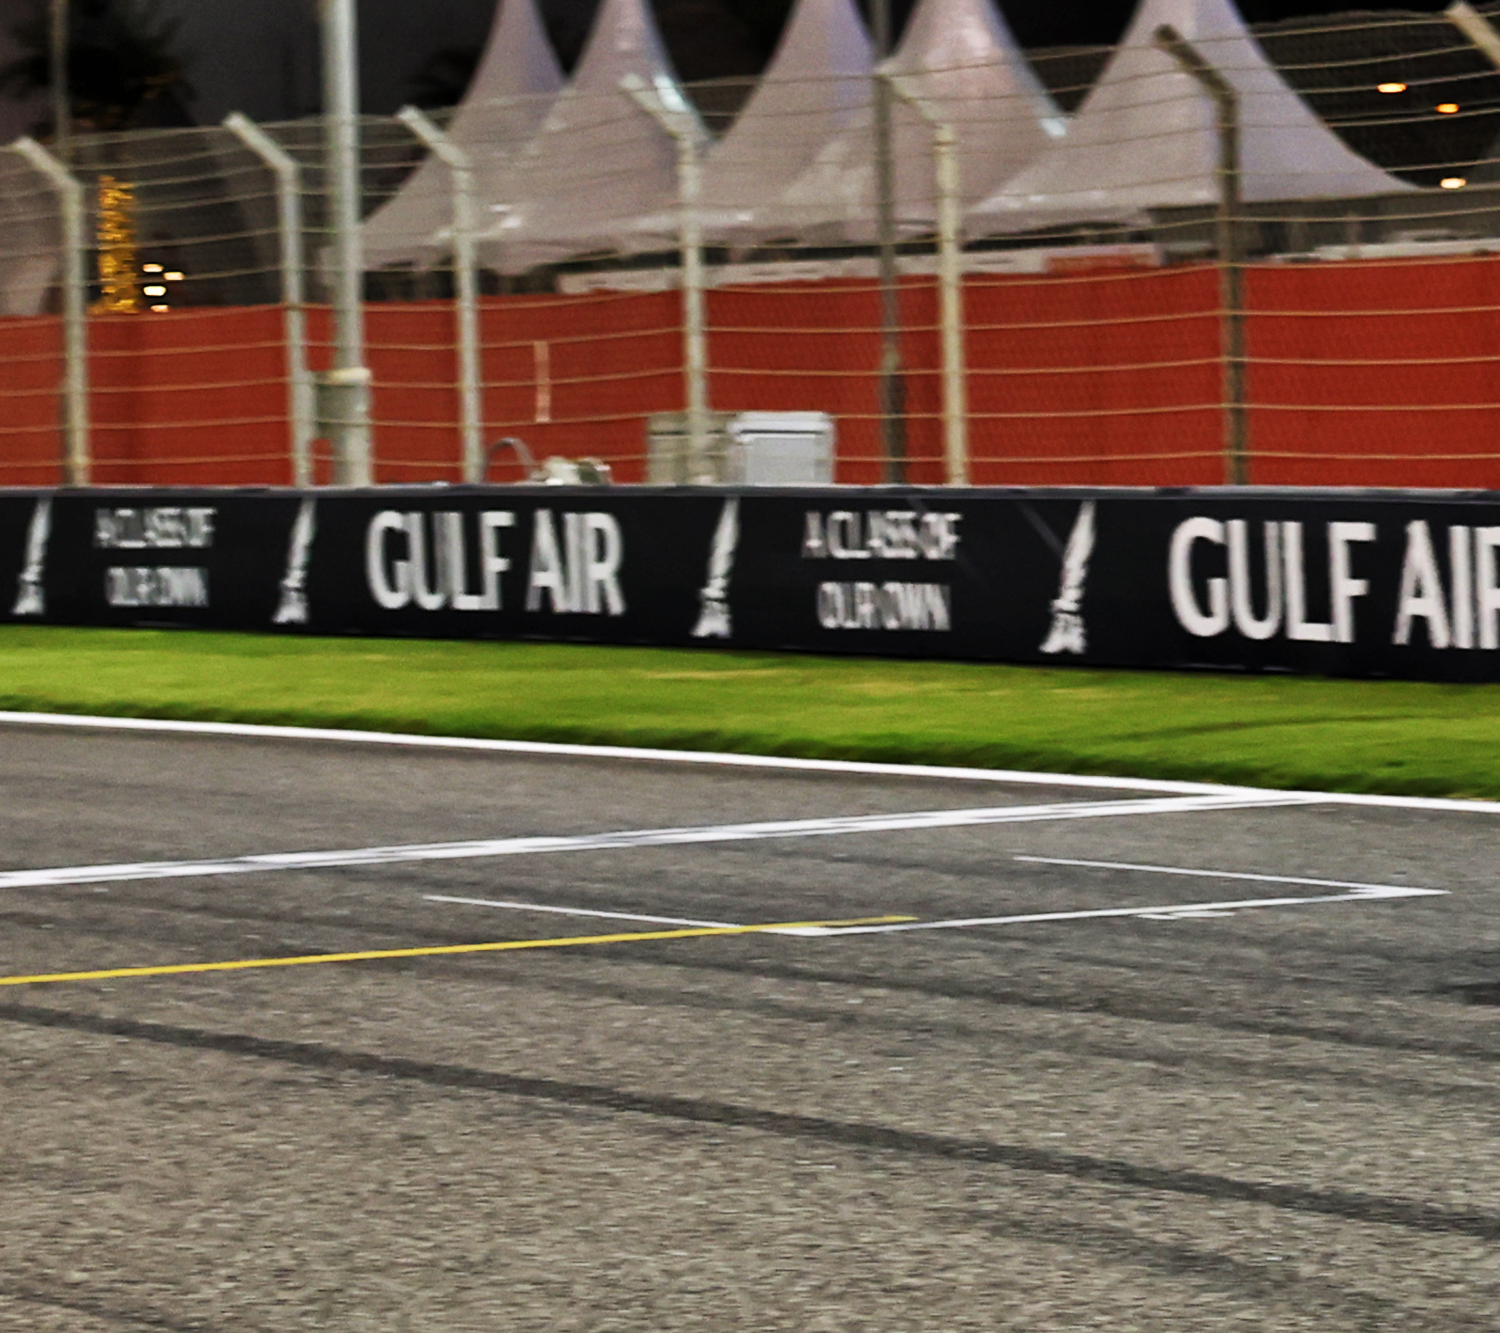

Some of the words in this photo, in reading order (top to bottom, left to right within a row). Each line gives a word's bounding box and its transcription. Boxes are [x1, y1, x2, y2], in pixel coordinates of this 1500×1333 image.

[368, 510, 516, 611] GULF
[525, 508, 626, 615] AIR
[1168, 517, 1376, 644] GULF
